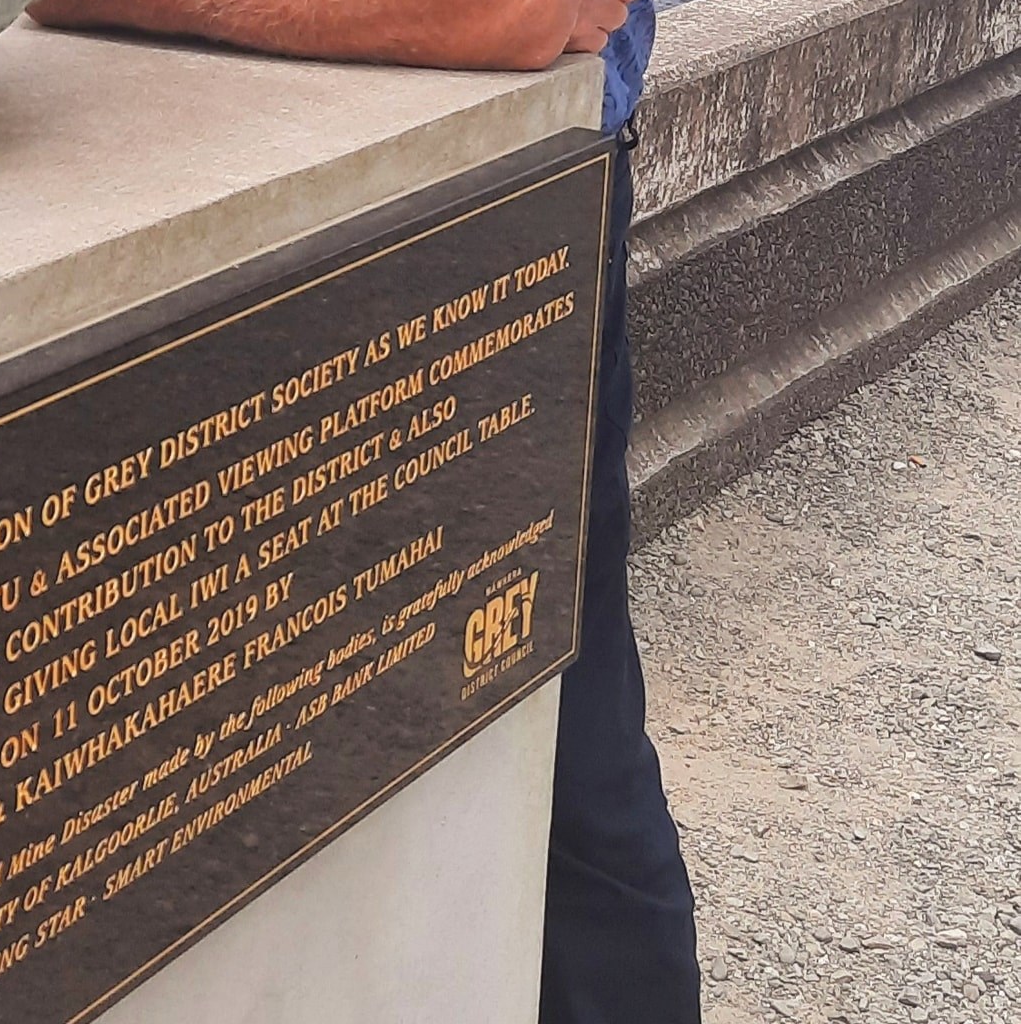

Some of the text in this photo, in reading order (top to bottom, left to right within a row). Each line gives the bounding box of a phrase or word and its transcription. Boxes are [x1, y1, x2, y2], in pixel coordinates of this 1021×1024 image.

[30, 568, 49, 597] &
[55, 479, 211, 585] ASSOCIATED
[217, 426, 314, 495] VIEWING
[320, 368, 424, 444] PLATFORM
[429, 291, 575, 385] COMMEMORATES
[41, 485, 76, 527] OF
[84, 447, 154, 505] GREY
[160, 392, 266, 469] DISTRICT
[271, 346, 360, 413] SOCIETY
[364, 332, 392, 367] AS
[396, 315, 427, 349] WE
[432, 284, 489, 333] KNOW
[492, 274, 510, 303] IT
[515, 245, 570, 292] TODAY.
[0, 721, 41, 768] ON
[52, 700, 78, 739] 11
[87, 629, 200, 716] OCTOBER
[207, 594, 258, 646] 2019
[265, 571, 295, 611] BY
[3, 639, 97, 715] GIVING
[105, 593, 183, 658] LOCAL
[191, 564, 228, 609] IWI
[235, 553, 252, 583] A
[258, 517, 313, 570] SEAT
[317, 499, 344, 537] AT
[349, 474, 389, 516] THE
[394, 428, 473, 491] COUNCIL
[478, 393, 536, 443] TABLE.
[6, 534, 197, 663] CONTRIBUTION
[204, 516, 234, 552] TO
[241, 487, 285, 532] THE
[292, 433, 385, 505] DISTRICT
[388, 428, 403, 450] &
[407, 396, 457, 442] ALSO
[15, 651, 237, 812] KAIWHAKAHAERE
[243, 584, 348, 670] FRANCOIS
[353, 525, 444, 600] TUMAHAI
[464, 570, 539, 666] GREY
[8, 833, 57, 880] Mine
[60, 780, 139, 846] Disaster
[142, 745, 190, 791] made
[194, 731, 216, 760] by
[219, 711, 248, 741] the
[244, 659, 325, 730] following
[381, 615, 394, 635] is
[395, 570, 464, 632] gratefully
[466, 508, 555, 580] acknowledged
[23, 875, 52, 912] OF
[184, 723, 282, 804] AUSTRALIA
[295, 693, 328, 730] ASB
[330, 661, 374, 707] BANK
[376, 622, 436, 676] LIMITED
[33, 895, 88, 947] STAR
[102, 837, 169, 901] SMART
[169, 740, 314, 853] ENVIRONMENTAL
